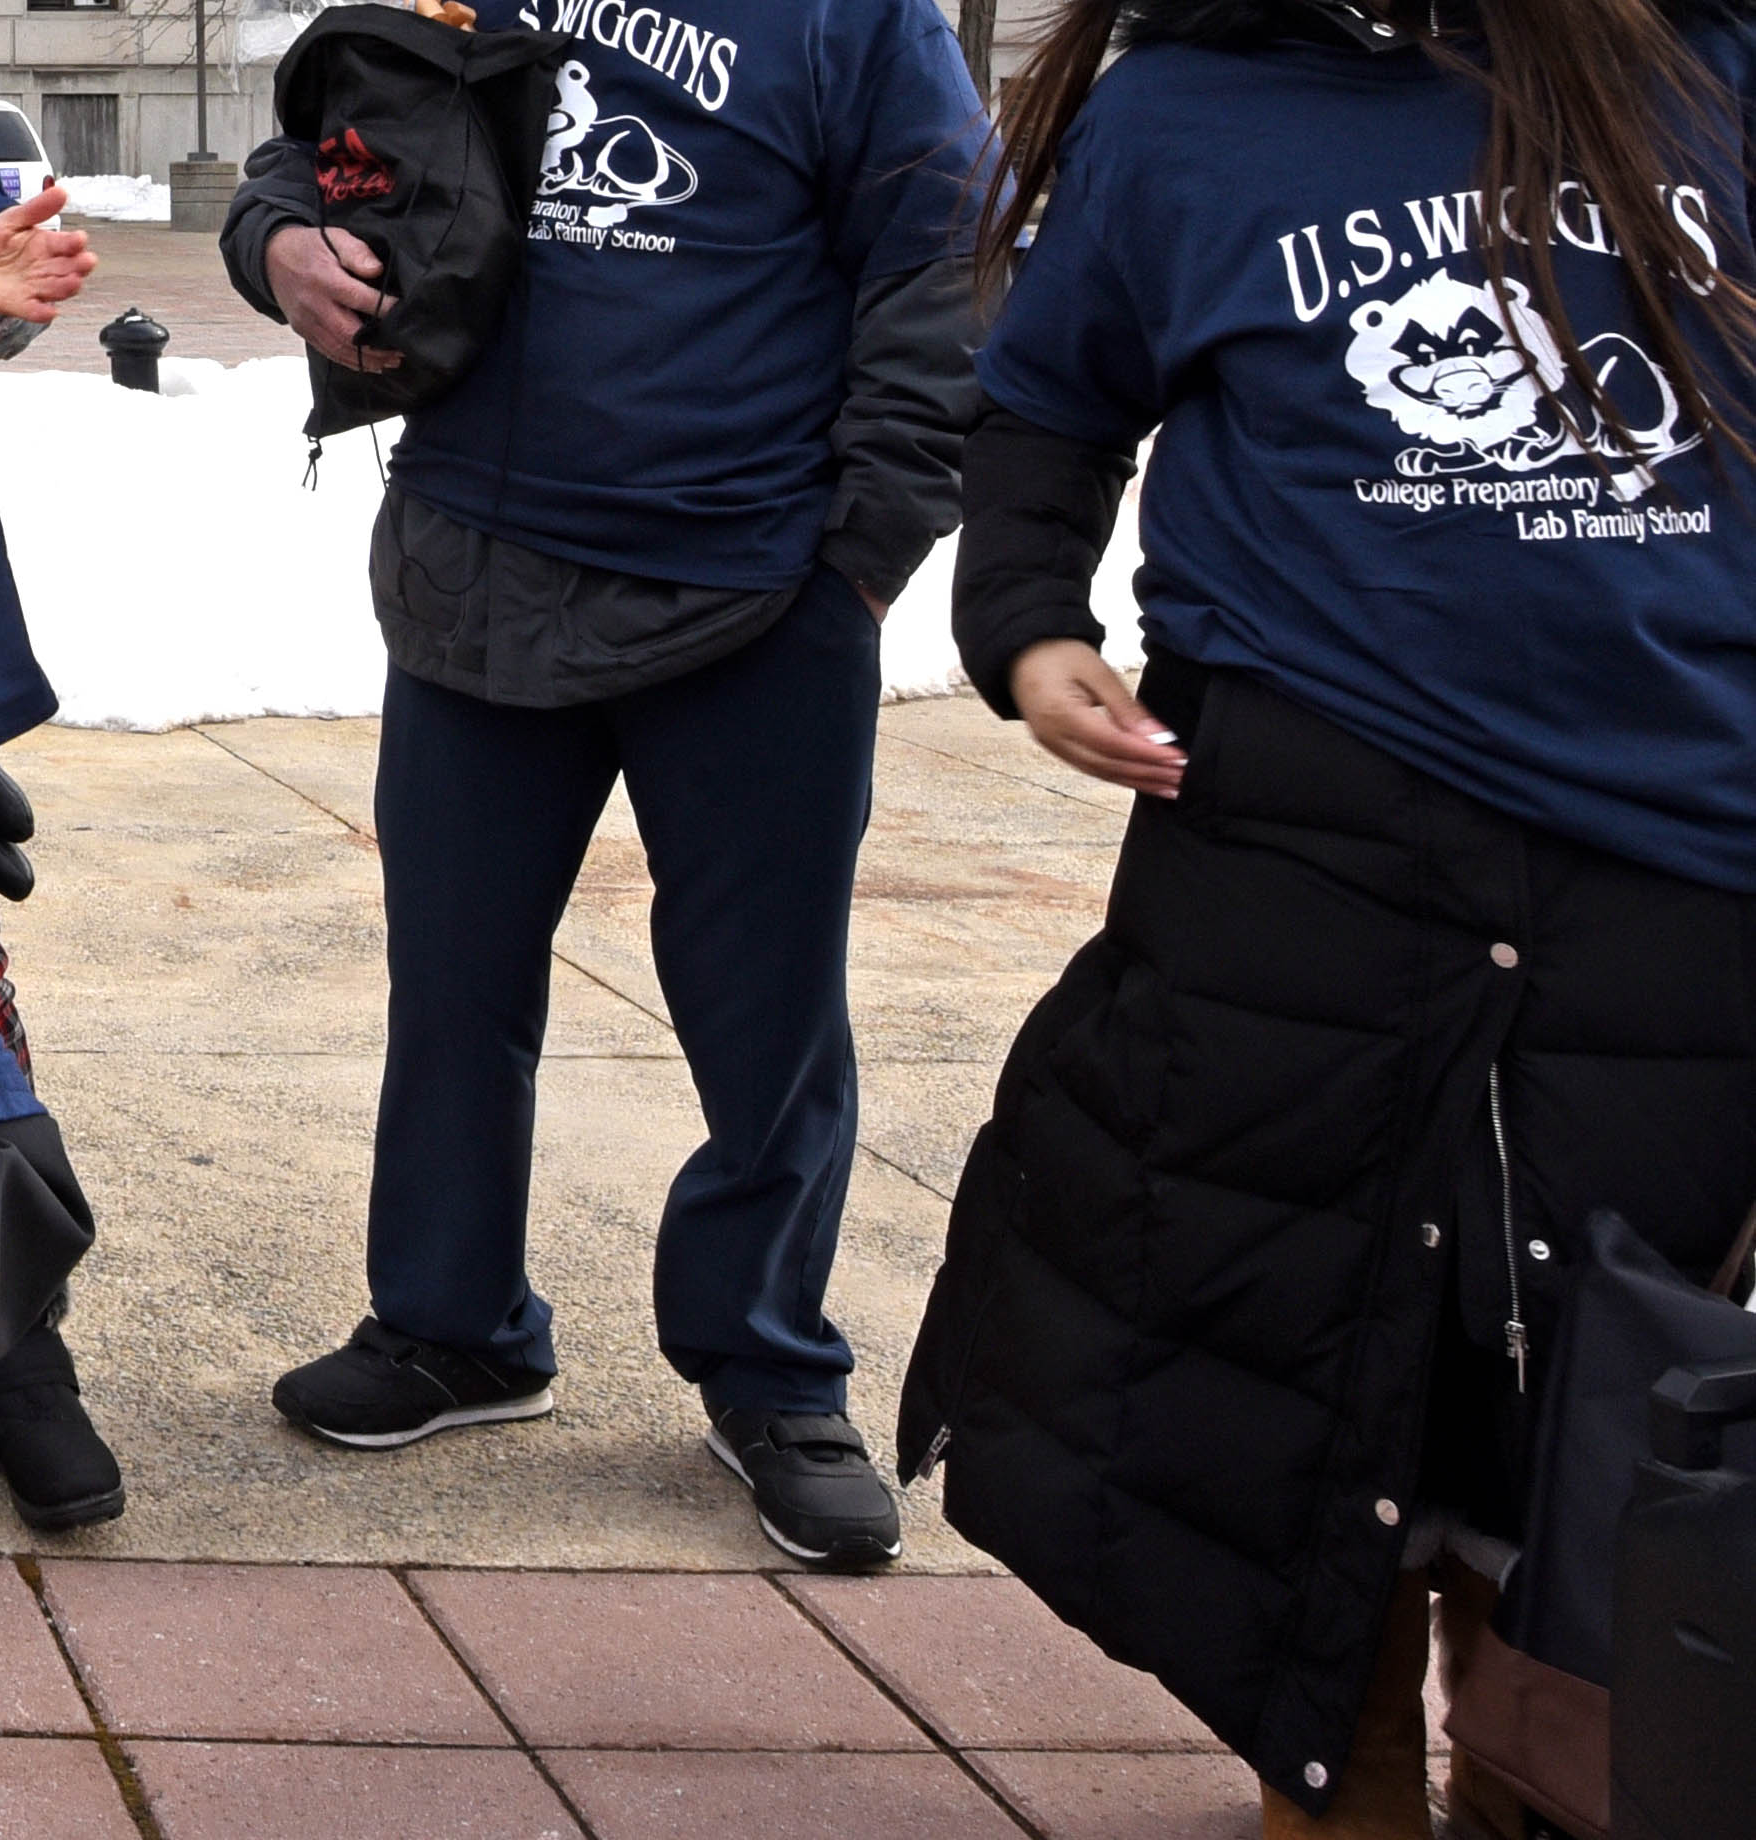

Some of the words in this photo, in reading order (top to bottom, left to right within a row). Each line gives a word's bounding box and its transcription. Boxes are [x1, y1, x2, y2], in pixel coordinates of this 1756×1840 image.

[530, 199, 582, 226] aratory
[554, 221, 608, 251] Family
[610, 228, 677, 254] School
[1353, 477, 1446, 513] College
[1452, 474, 1601, 512] Preparatory
[1516, 510, 1567, 540] Lab
[1571, 507, 1647, 544] Family
[1646, 504, 1711, 535] School
